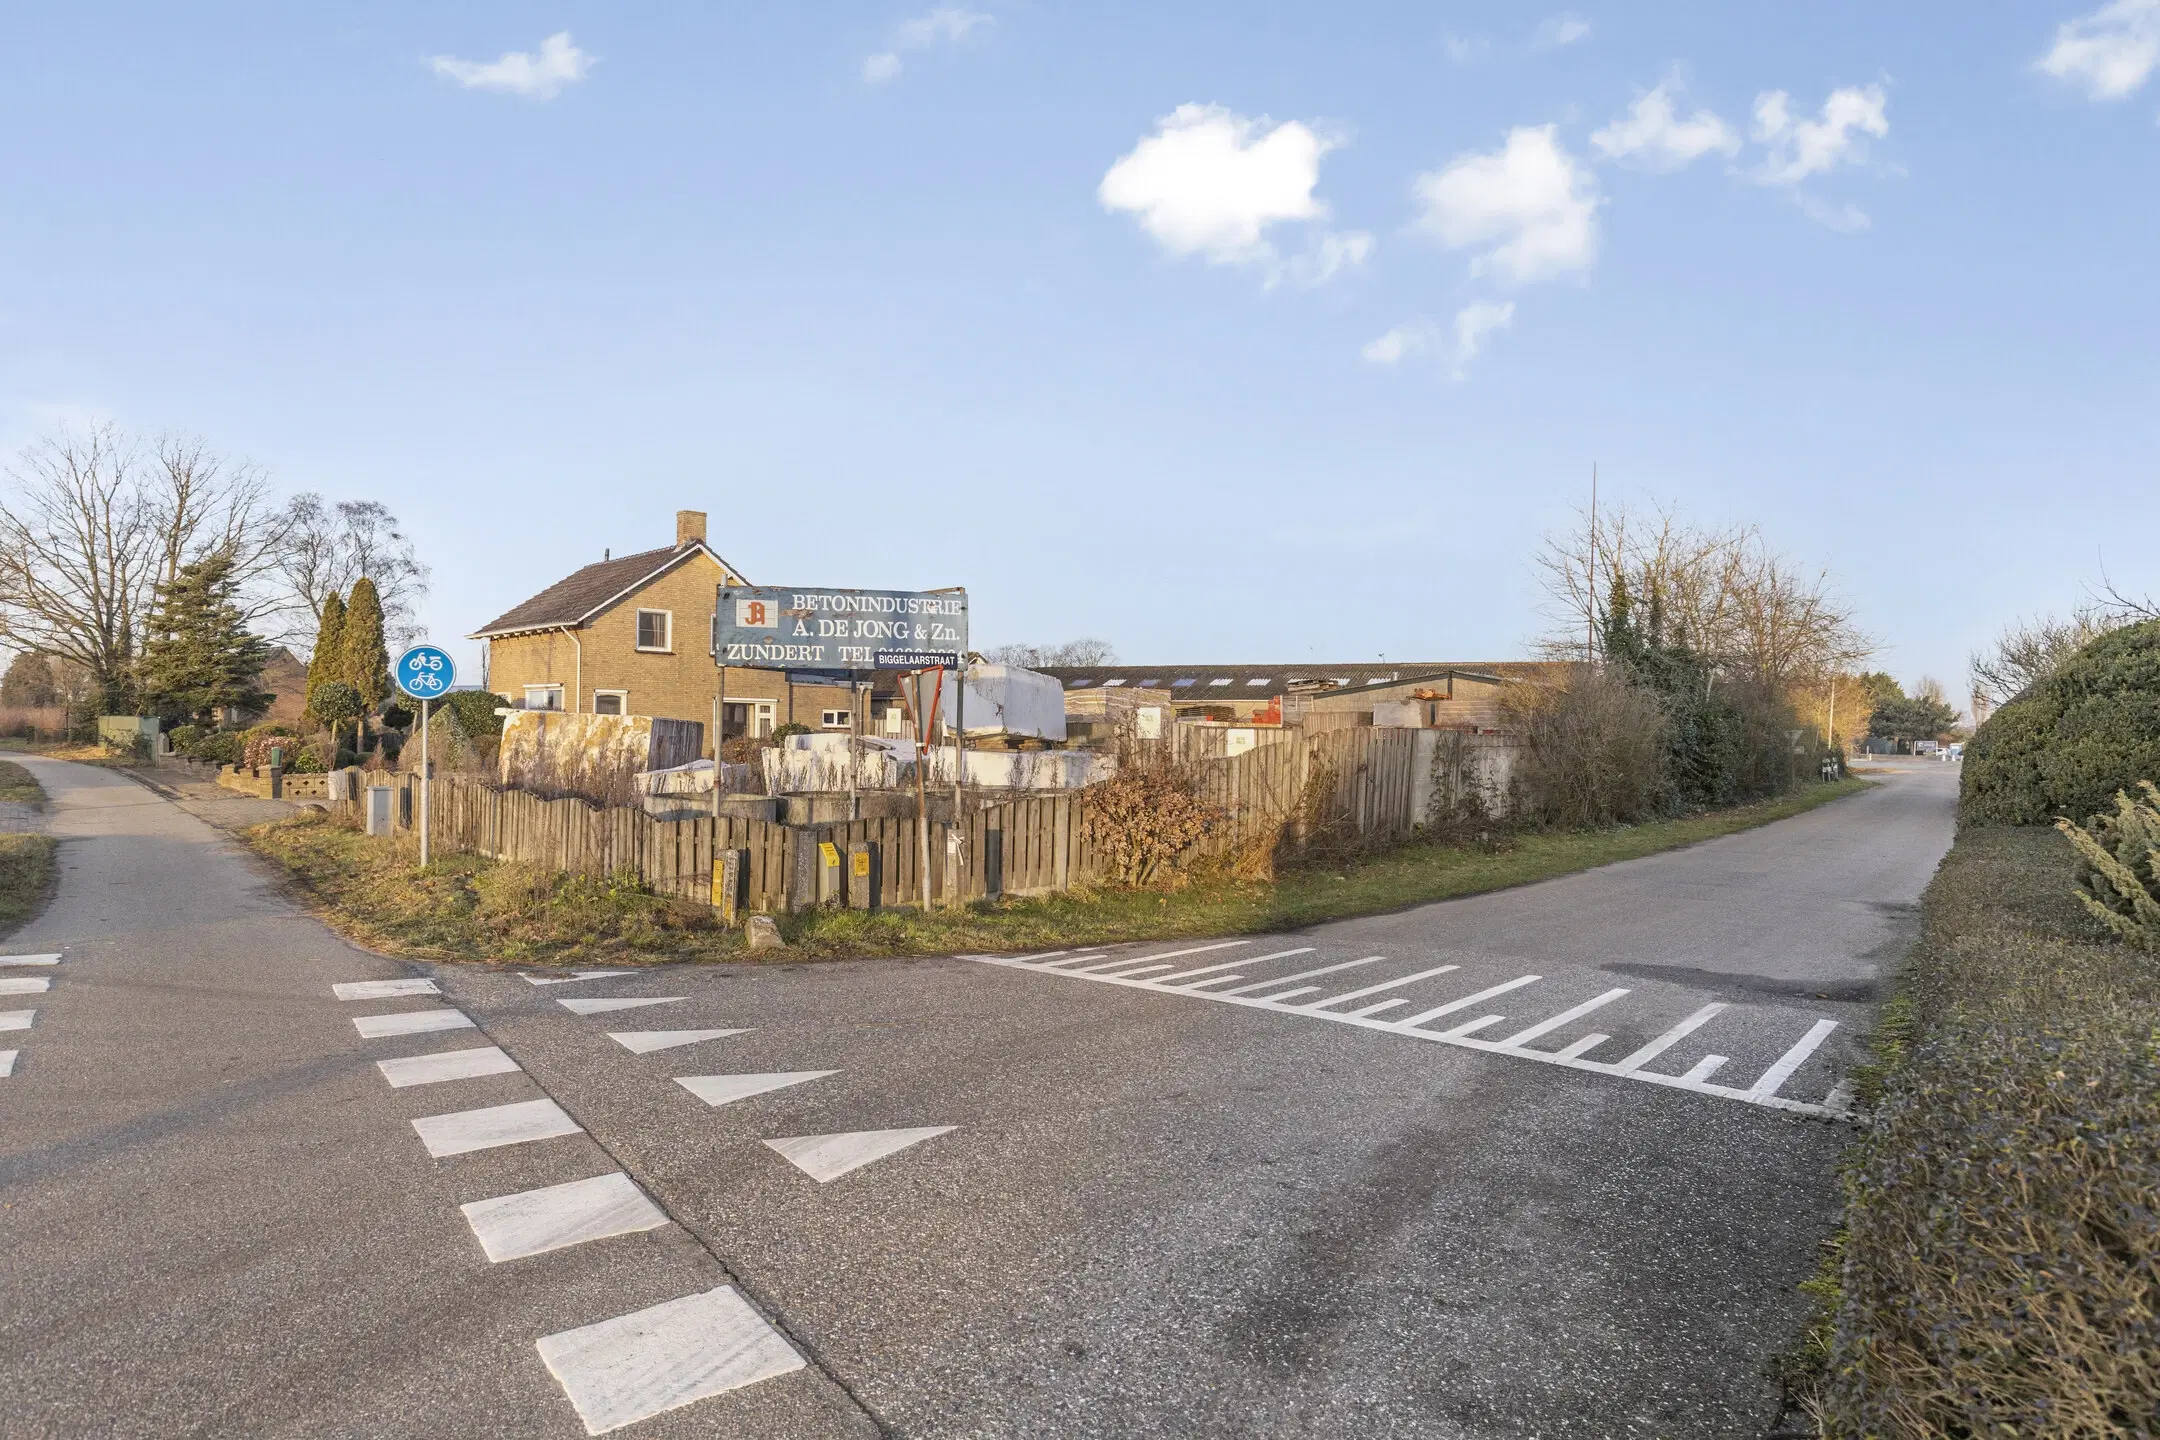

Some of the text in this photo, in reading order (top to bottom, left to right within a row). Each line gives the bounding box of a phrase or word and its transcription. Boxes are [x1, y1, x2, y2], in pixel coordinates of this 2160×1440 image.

[792, 594, 962, 615] BETONINDUSTRIE
[792, 619, 960, 640] A. DE JONG & Zn.
[727, 643, 825, 661] ZUNDERT
[878, 654, 955, 665] BIGGELAARSTRAAT
